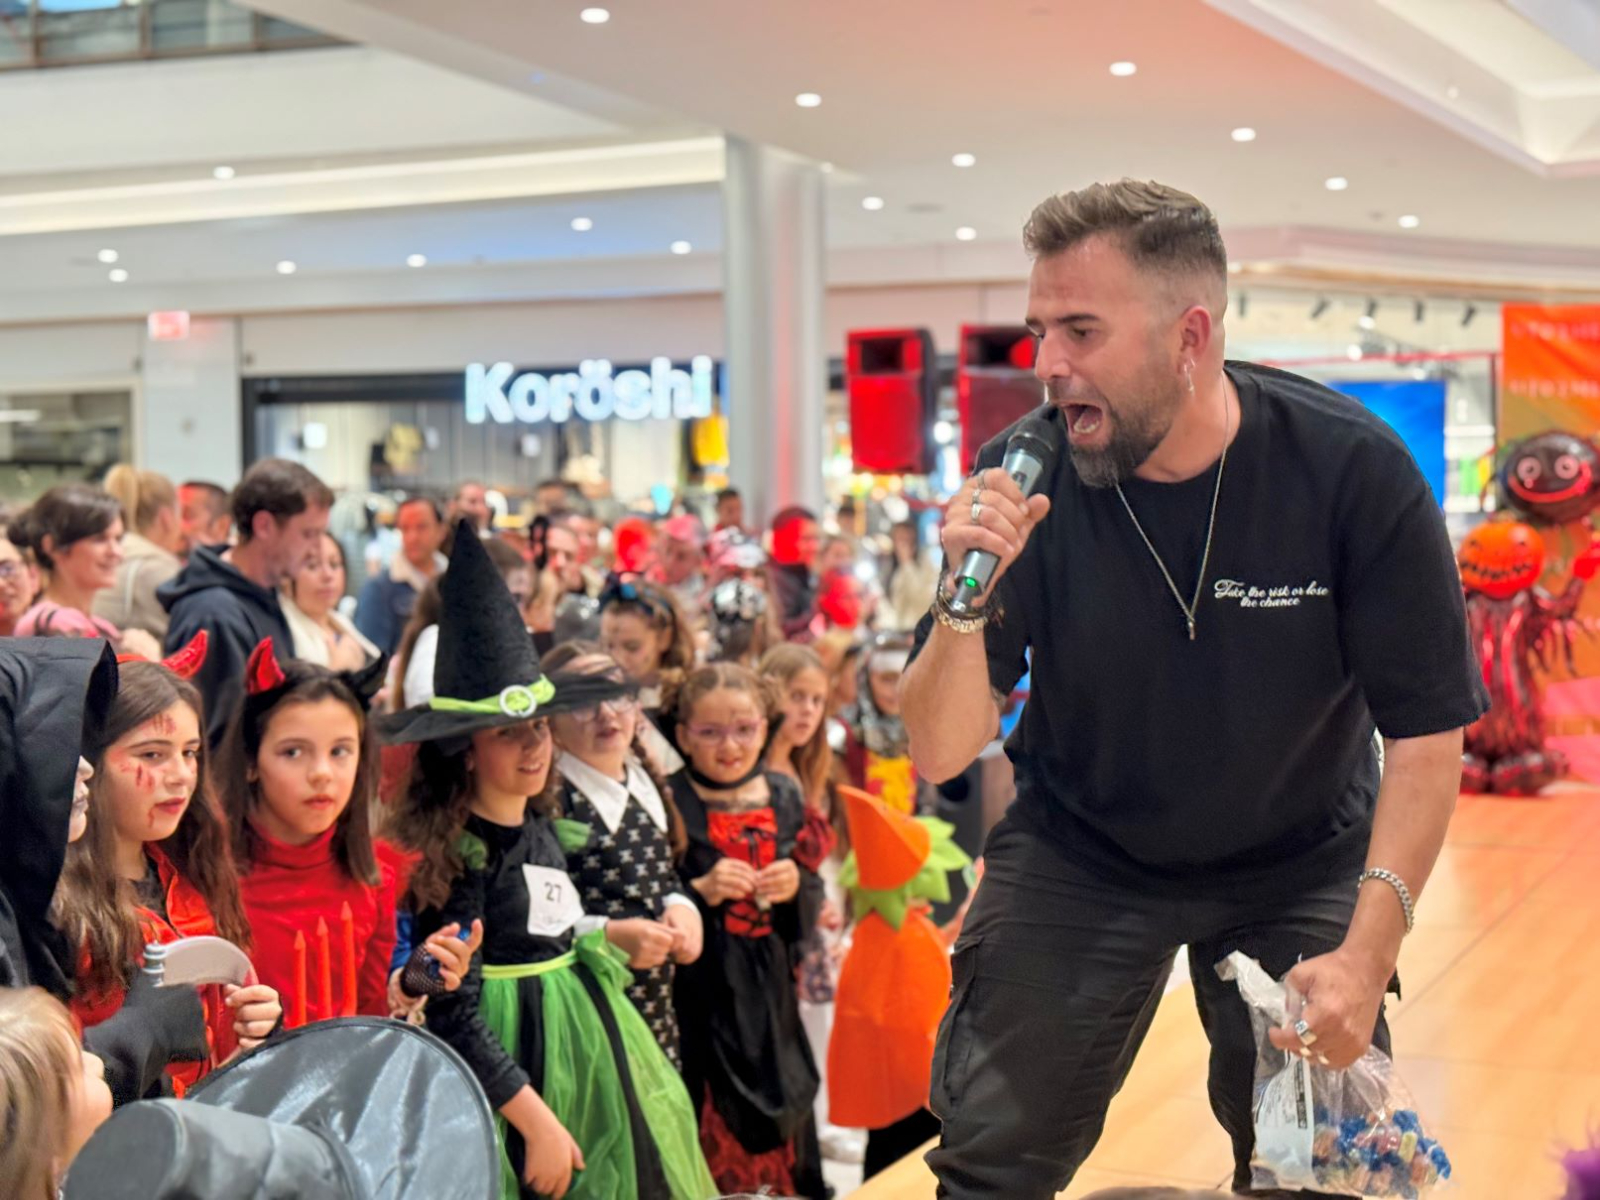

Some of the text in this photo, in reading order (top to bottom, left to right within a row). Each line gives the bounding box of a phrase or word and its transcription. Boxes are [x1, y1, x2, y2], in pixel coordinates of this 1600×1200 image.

[464, 354, 713, 424] Koröshi
[1214, 579, 1329, 599] Take the risk or lose
[1240, 597, 1301, 607] the chance
[544, 881, 562, 903] 27
